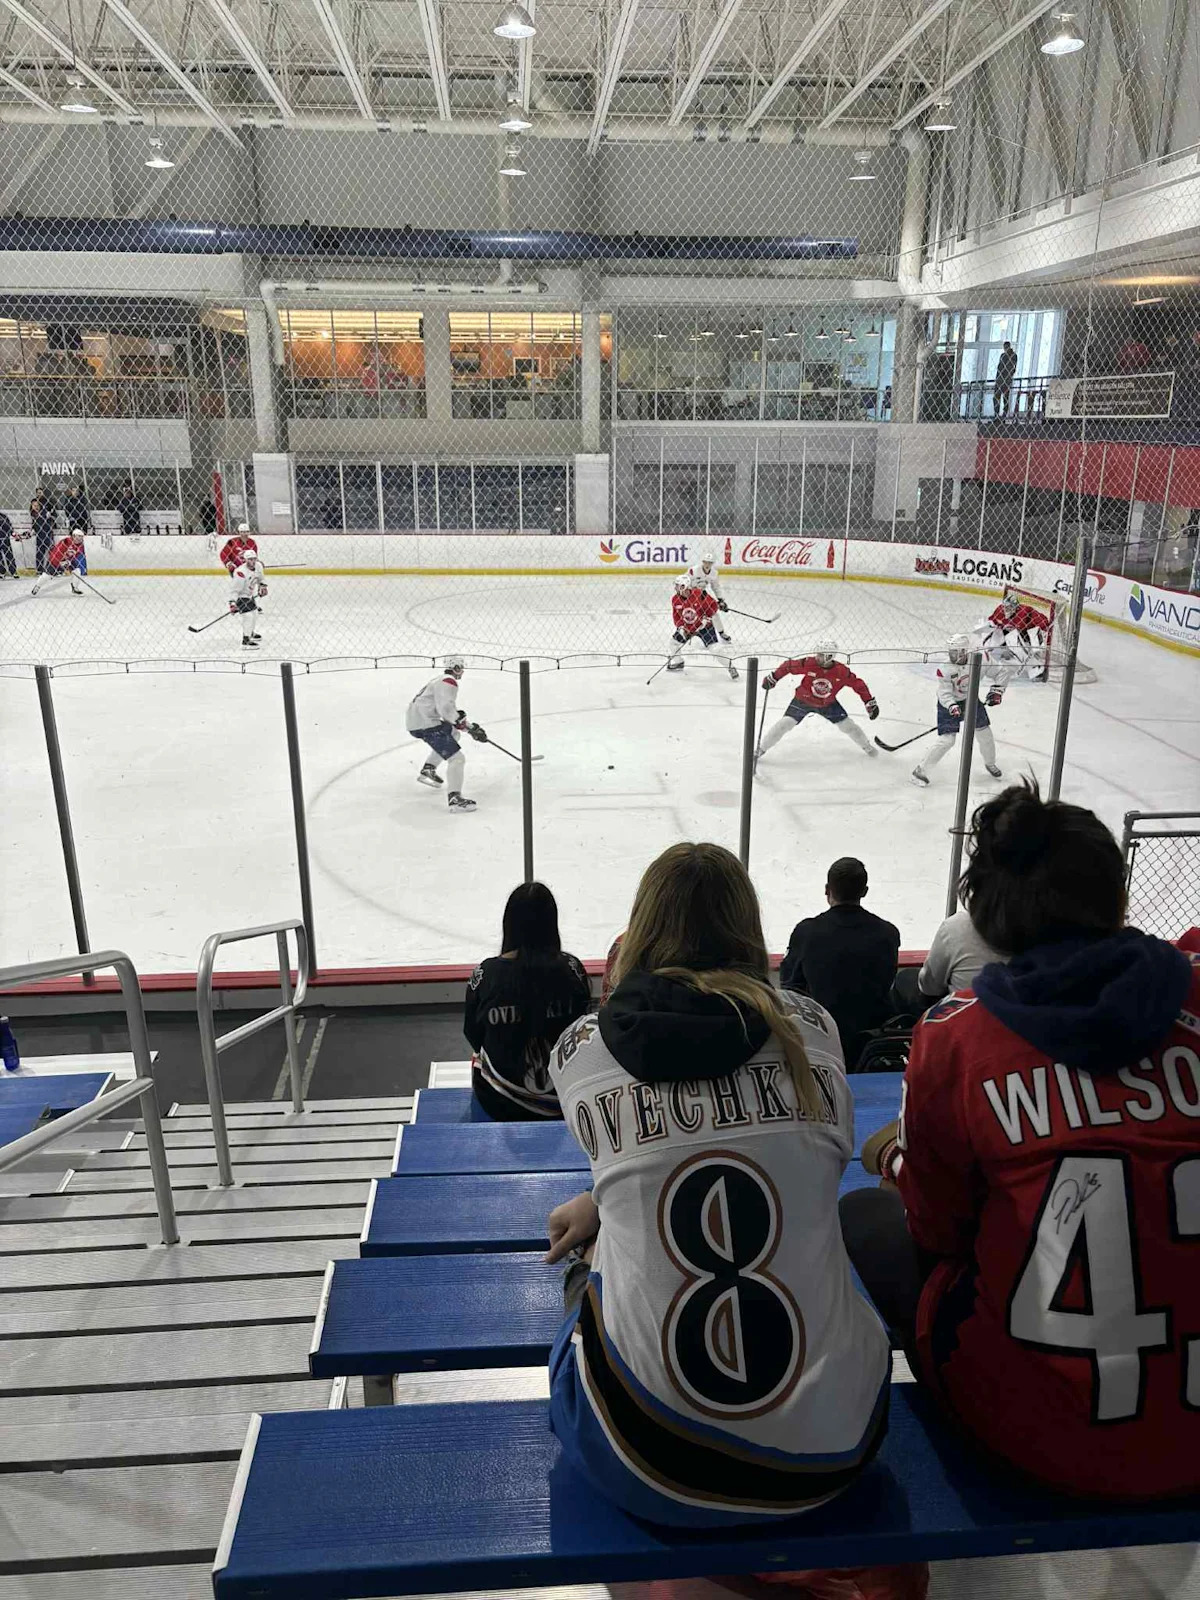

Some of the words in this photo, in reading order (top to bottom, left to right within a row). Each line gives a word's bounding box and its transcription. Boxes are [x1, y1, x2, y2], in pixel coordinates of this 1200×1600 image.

[41, 462, 76, 475] AWAY
[625, 541, 688, 563] Giant
[741, 539, 815, 566] Coca-Cola
[953, 553, 1023, 583] LOGAN'S
[1055, 580, 1092, 597] Capal
[575, 1060, 838, 1161] OVECHKN
[657, 1149, 806, 1420] 8
